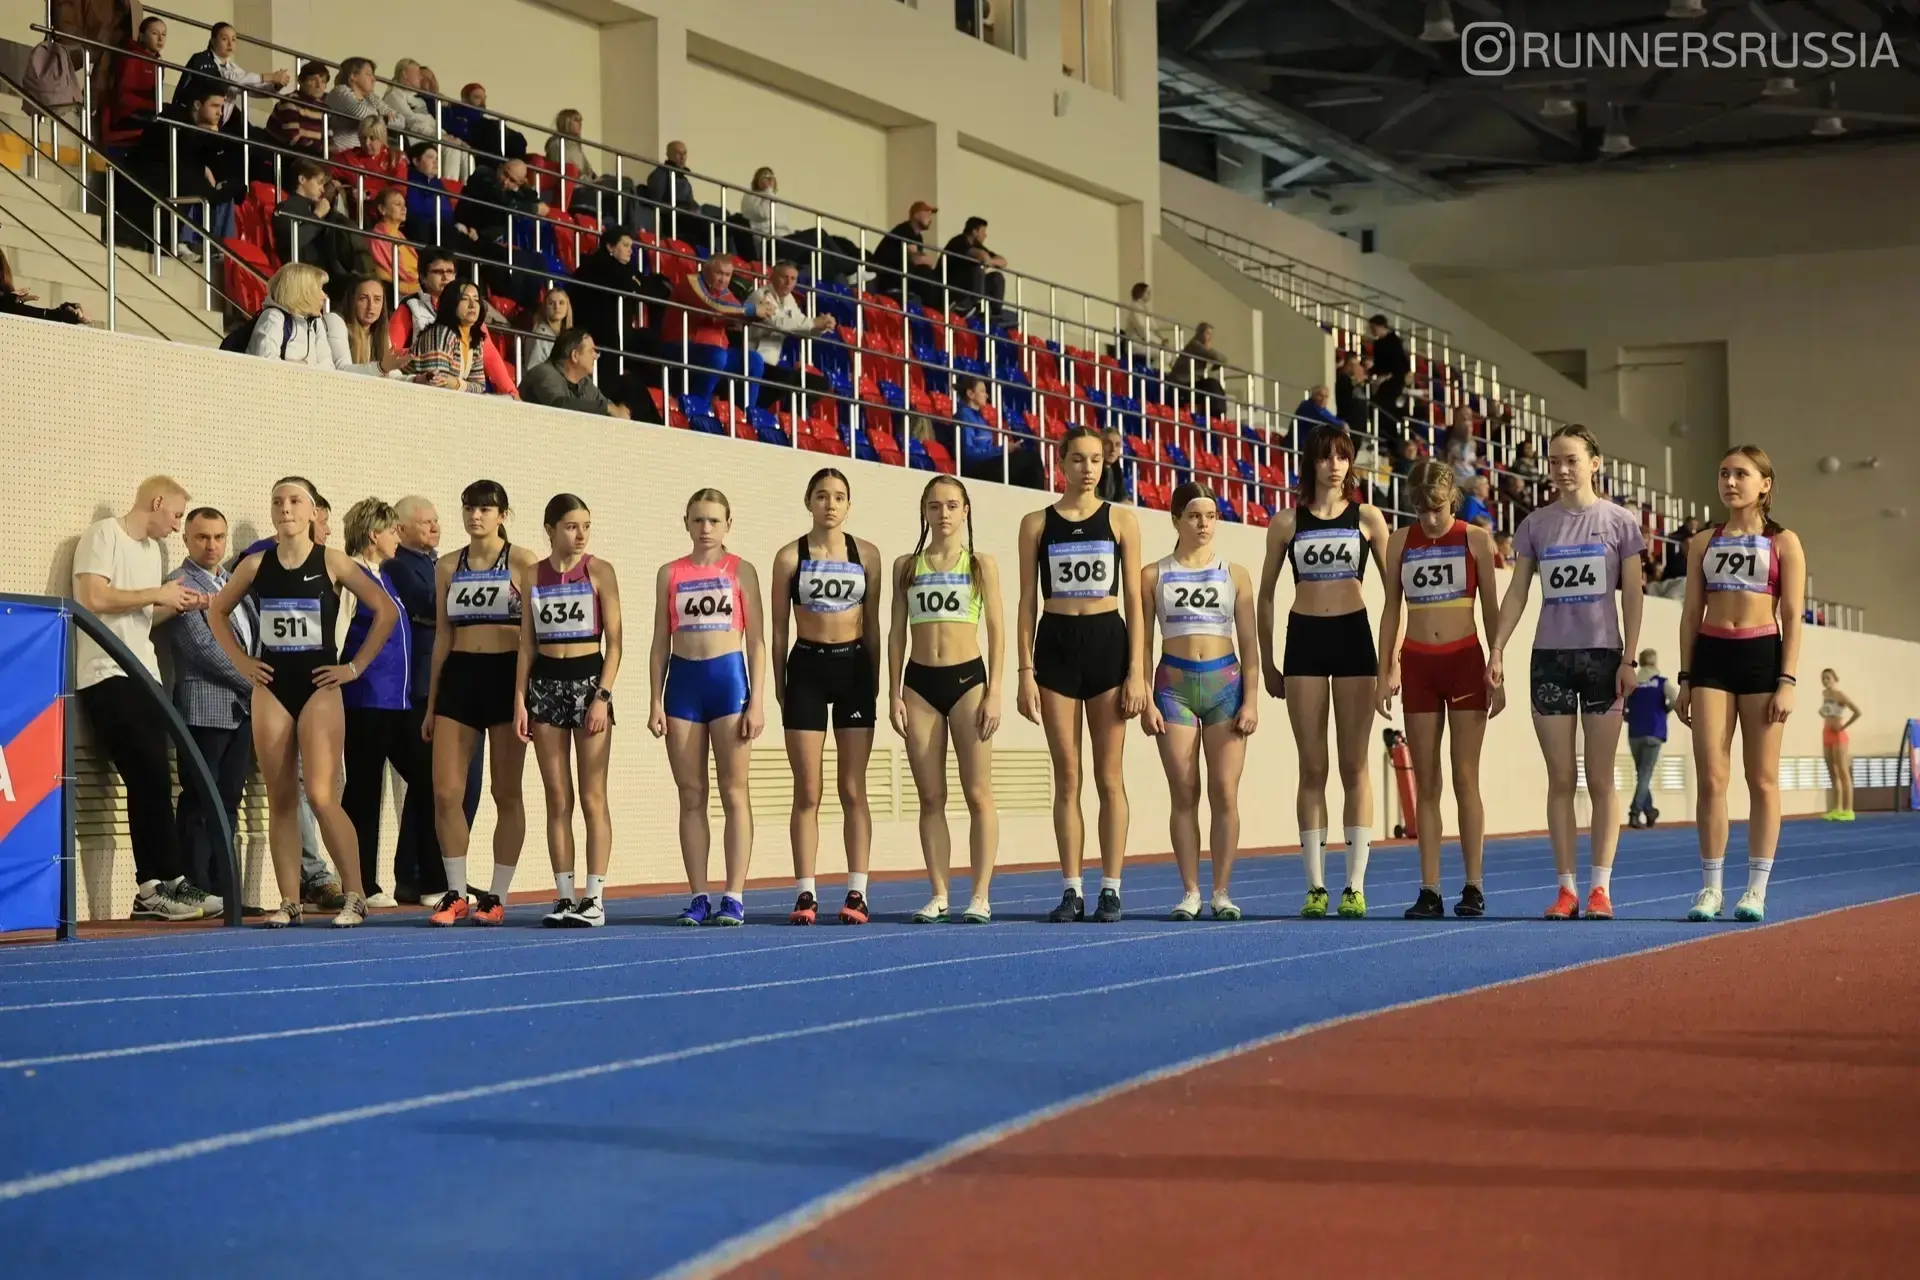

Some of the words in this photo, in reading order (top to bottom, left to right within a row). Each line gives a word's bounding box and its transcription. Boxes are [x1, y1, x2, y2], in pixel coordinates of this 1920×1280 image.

[1303, 543, 1352, 566] 664
[1715, 552, 1756, 577] 791
[1058, 560, 1107, 583] 308
[1412, 563, 1454, 588] 631
[1549, 564, 1597, 589] 624
[455, 586, 500, 607] 467
[809, 578, 856, 599] 207
[1174, 587, 1220, 608] 262
[539, 601, 585, 624] 634
[684, 595, 733, 617] 404
[916, 590, 960, 613] 106
[273, 617, 308, 638] 511
